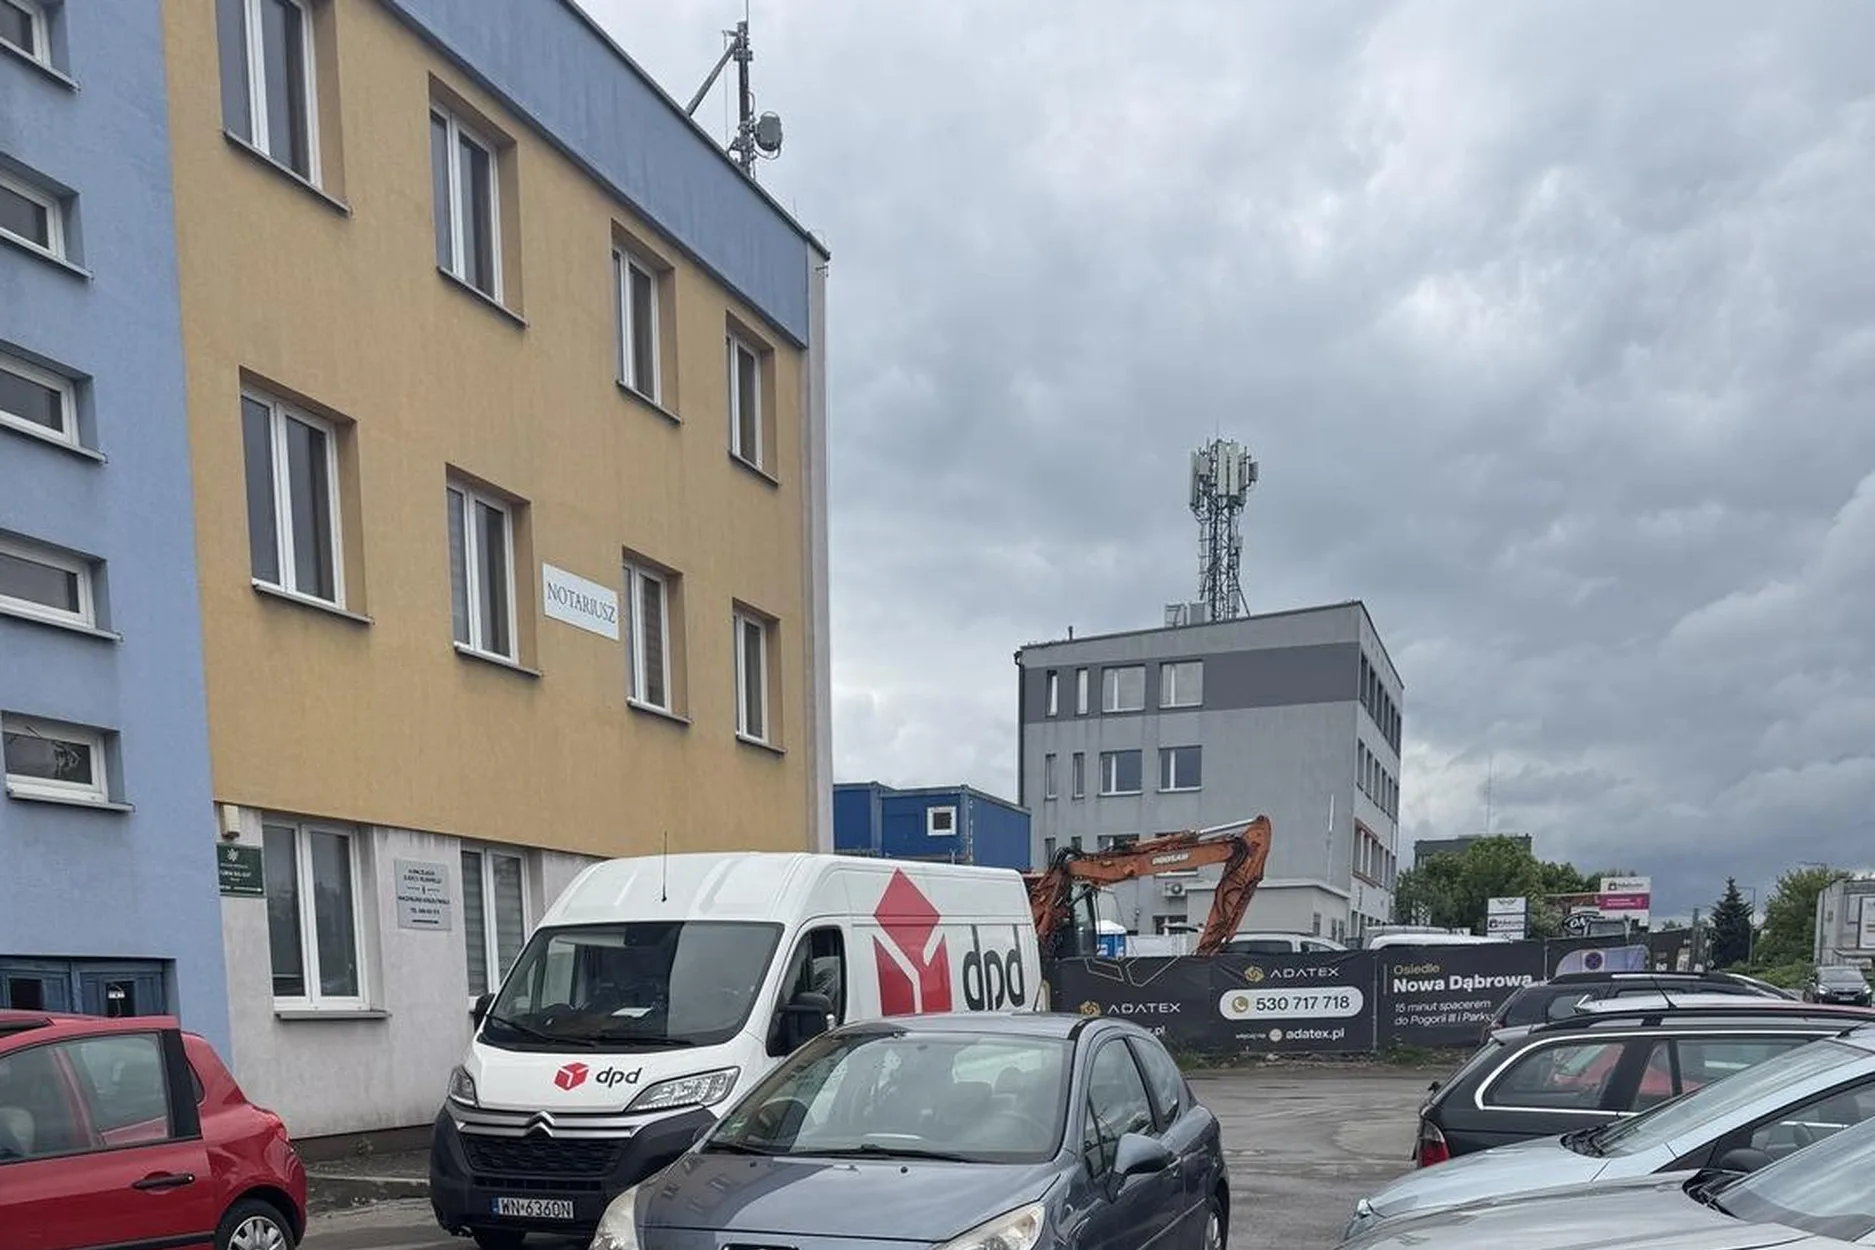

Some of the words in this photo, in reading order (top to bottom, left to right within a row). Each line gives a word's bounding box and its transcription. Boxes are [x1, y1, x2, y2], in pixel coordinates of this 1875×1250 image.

[547, 582, 616, 624] NOTARIUSZ
[962, 924, 1026, 1011] dpd
[1270, 967, 1340, 979] ADATEX
[1393, 963, 1440, 975] Osiedle
[1393, 978, 1445, 993] Nowa
[1450, 974, 1532, 992] Dąbrowa
[1107, 1002, 1181, 1014] ADATEX
[1256, 997, 1288, 1011] 530
[1293, 997, 1318, 1010] 717
[1323, 996, 1350, 1009] 718
[1407, 1002, 1438, 1012] minut
[1440, 1000, 1492, 1011] spacerem
[1394, 1016, 1408, 1025] do
[1286, 1027, 1345, 1041] adatex.pl
[595, 1066, 643, 1088] dpd
